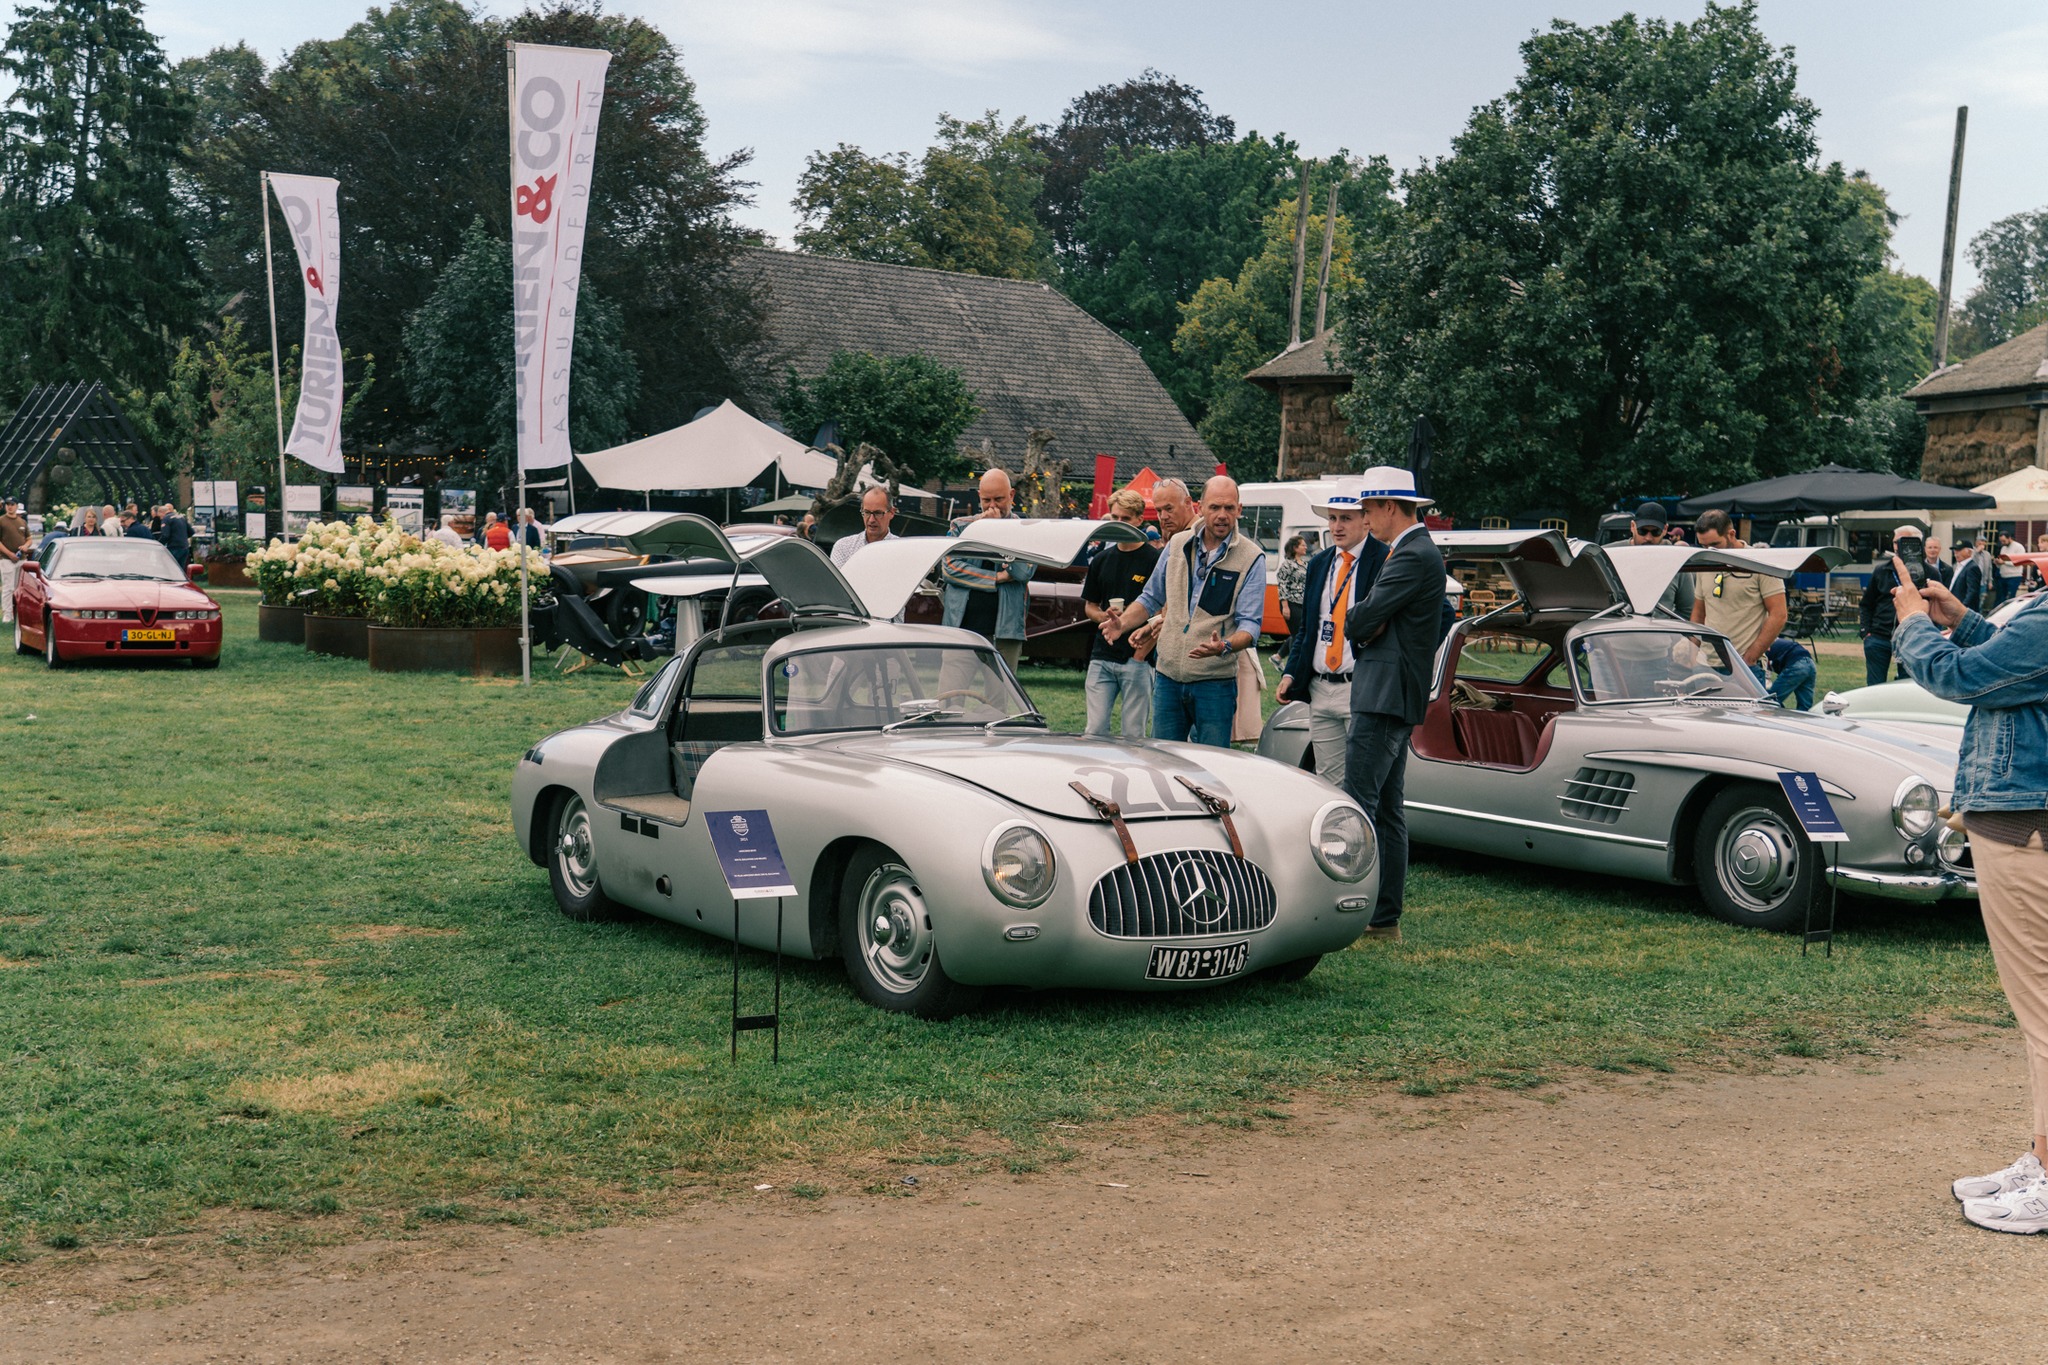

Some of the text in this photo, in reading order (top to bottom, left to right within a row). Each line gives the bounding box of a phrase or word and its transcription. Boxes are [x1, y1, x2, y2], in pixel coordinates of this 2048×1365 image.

[514, 76, 566, 434] IEN & CO
[294, 298, 338, 445] TURIEN
[131, 631, 172, 640] 30-GL-NJ
[1156, 944, 1246, 978] W83-3146
